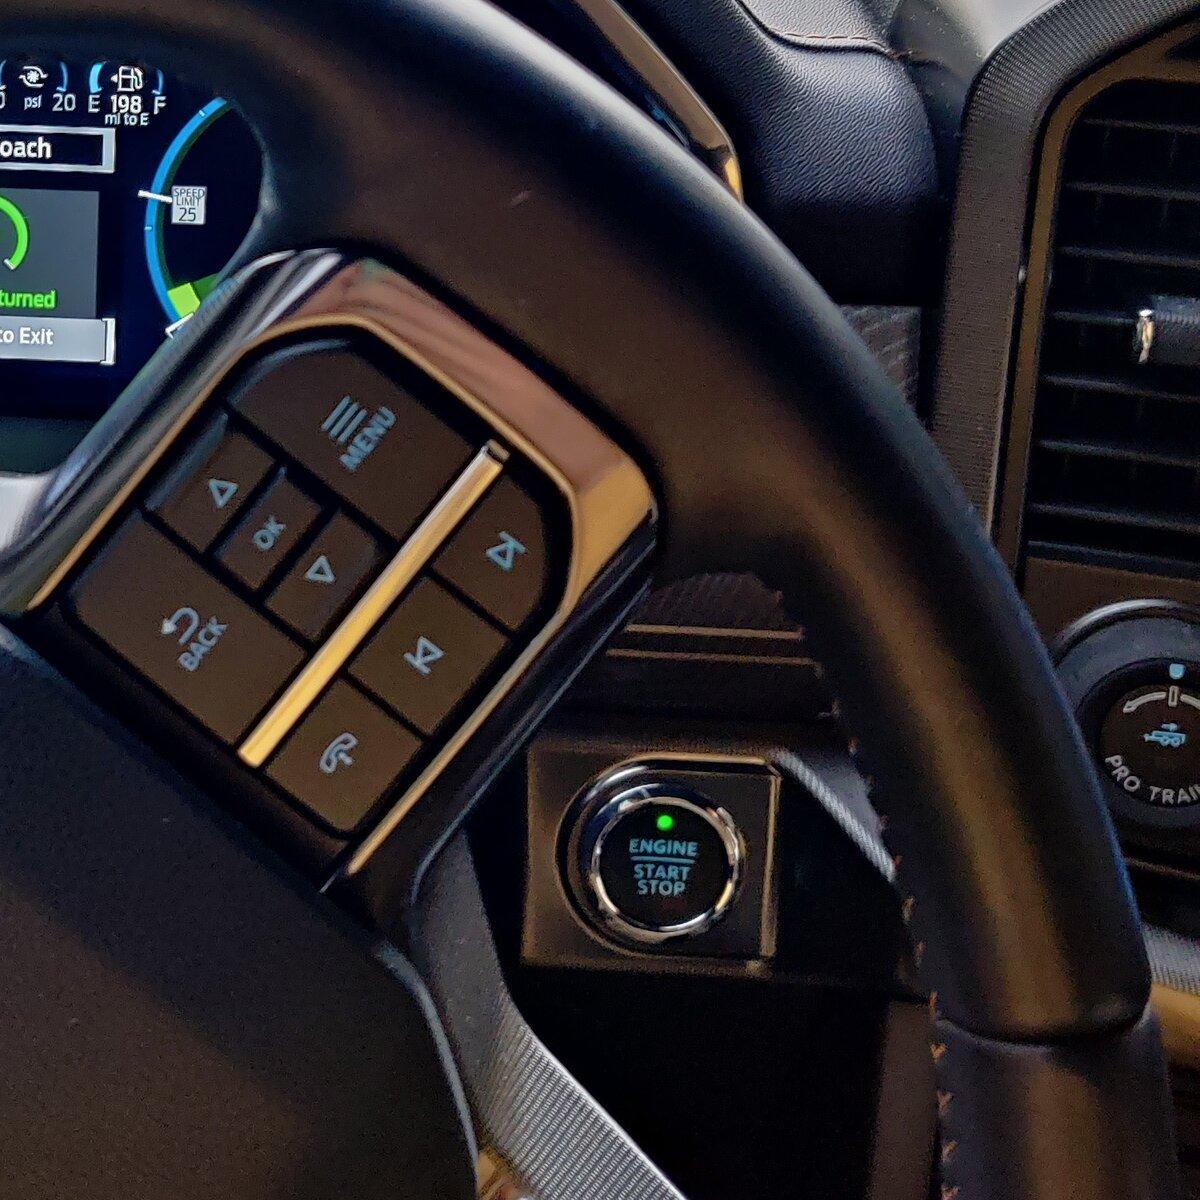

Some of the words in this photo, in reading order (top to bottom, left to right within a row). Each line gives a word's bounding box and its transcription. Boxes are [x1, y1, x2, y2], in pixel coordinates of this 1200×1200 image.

[52, 93, 77, 112] 20
[88, 94, 101, 113] E
[110, 94, 142, 114] 198
[153, 95, 167, 115] F
[123, 113, 138, 126] to
[140, 112, 150, 126] E
[173, 188, 205, 198] SPEED
[178, 207, 197, 222] 25
[19, 327, 54, 345] Exit
[340, 407, 396, 471] MENU
[253, 515, 286, 550] OK
[179, 615, 229, 672] BACK
[1105, 755, 1140, 792] PRO
[629, 840, 698, 856] ENGINE
[634, 864, 691, 880] START
[638, 881, 685, 895] STOP
